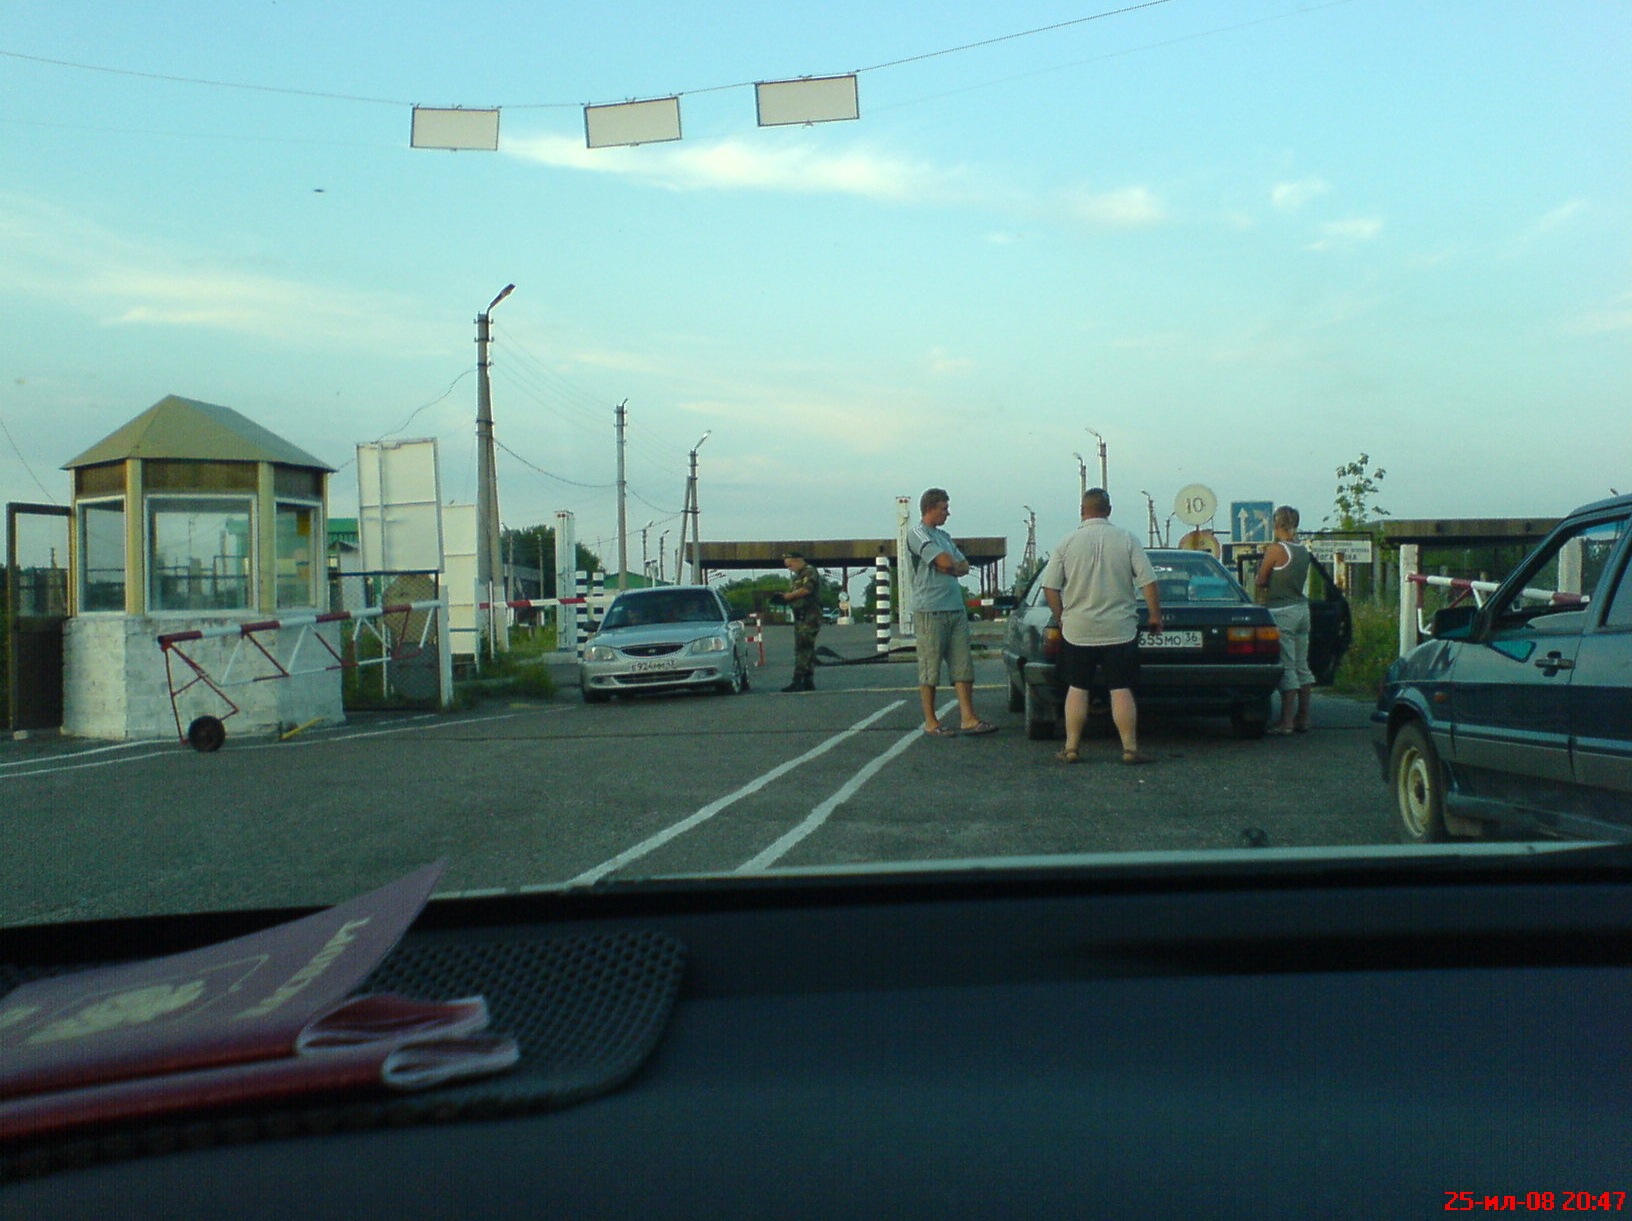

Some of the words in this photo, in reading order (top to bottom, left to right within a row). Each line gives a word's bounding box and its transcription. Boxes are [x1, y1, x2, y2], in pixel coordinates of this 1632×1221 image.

[1185, 497, 1204, 514] 10
[1138, 631, 1182, 647] 655МО
[1185, 631, 1198, 642] 36
